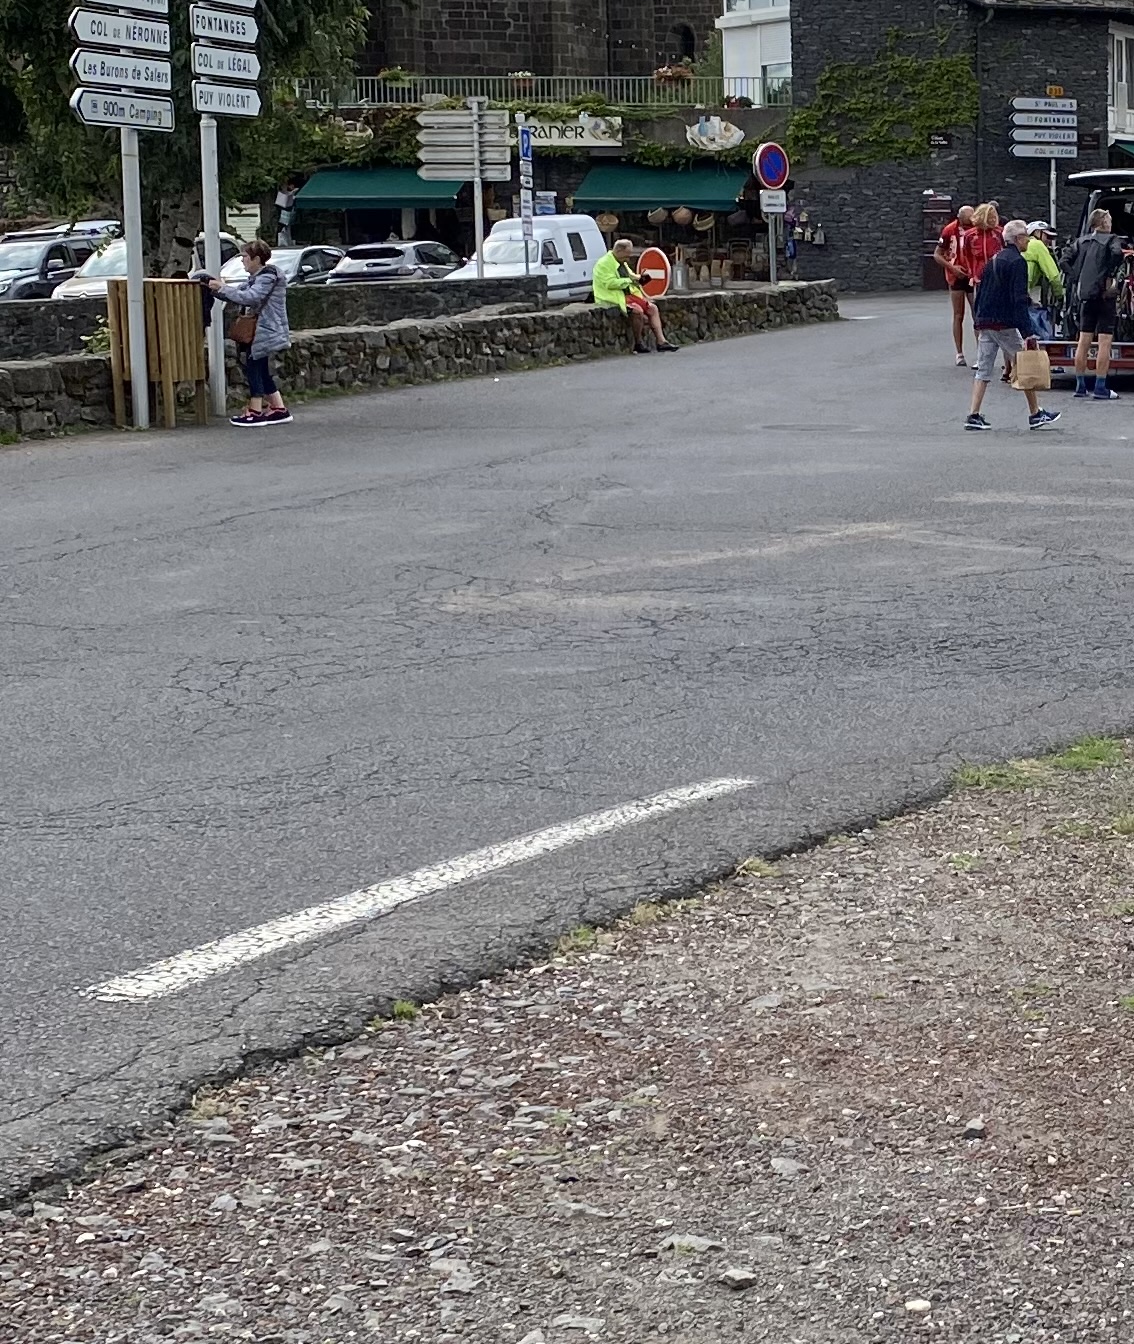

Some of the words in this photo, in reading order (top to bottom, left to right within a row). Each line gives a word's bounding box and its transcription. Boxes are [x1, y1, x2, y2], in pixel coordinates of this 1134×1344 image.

[90, 19, 108, 37] COL
[125, 21, 168, 46] NÉRONNE
[195, 14, 246, 36] FONTANGES
[83, 58, 97, 76] Les
[100, 60, 129, 80] Burons
[131, 64, 141, 81] de
[143, 66, 169, 84] Salers
[197, 52, 214, 69] COL
[227, 52, 252, 74] LÉGAL
[198, 89, 215, 106] PUY
[217, 91, 251, 110] VIOLENT
[103, 100, 126, 118] 900m
[128, 103, 163, 126] Camping
[1034, 116, 1075, 125] FONTANGES
